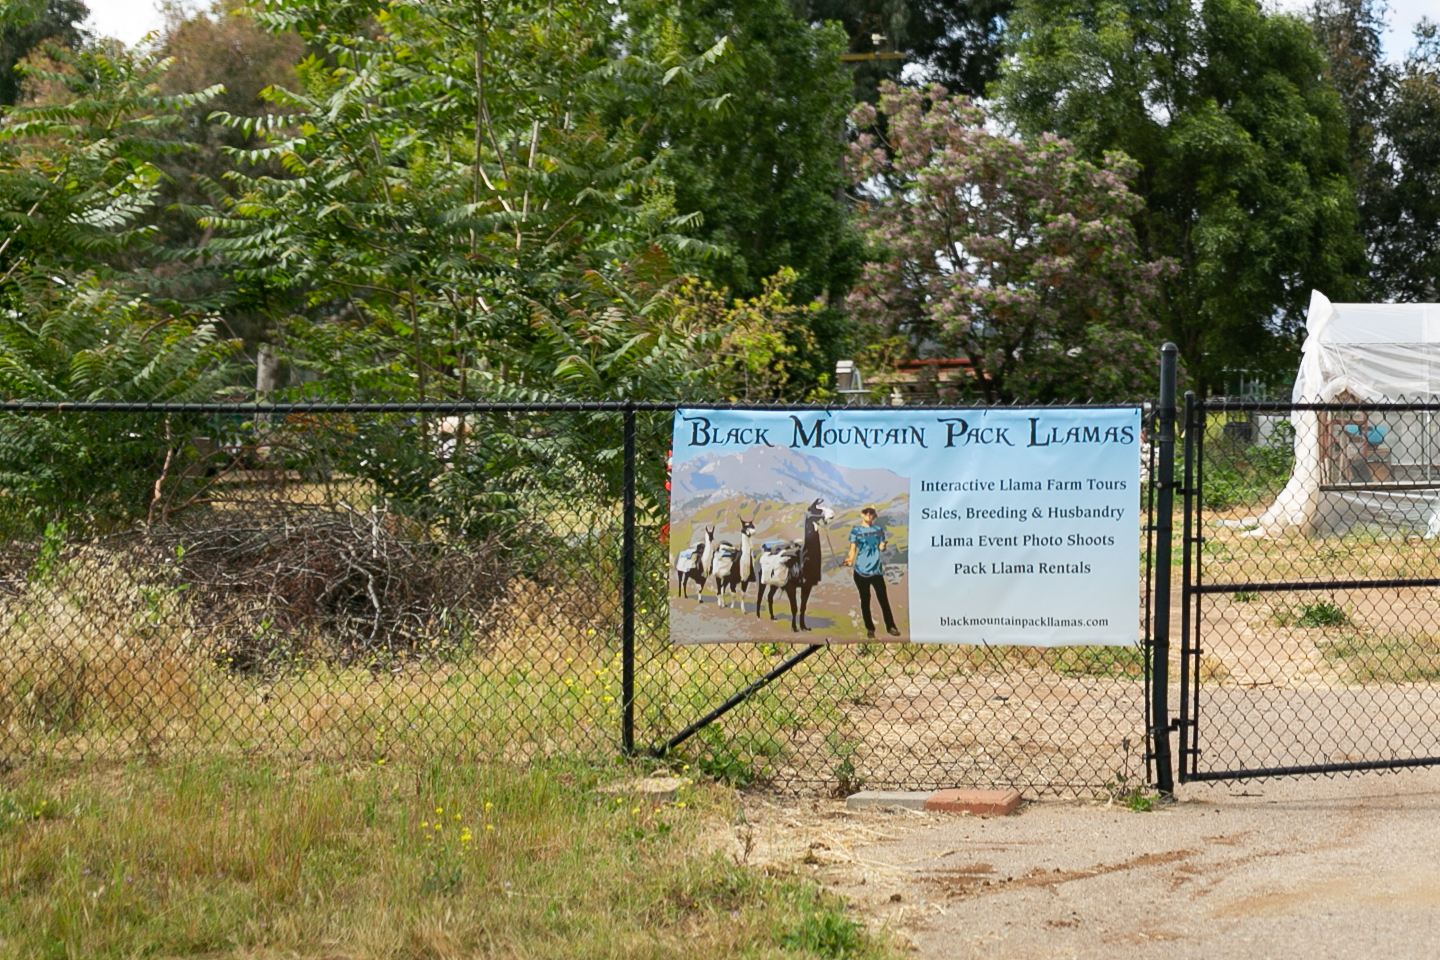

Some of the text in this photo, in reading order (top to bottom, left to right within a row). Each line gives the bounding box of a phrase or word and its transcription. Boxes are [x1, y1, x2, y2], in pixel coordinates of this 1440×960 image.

[921, 478, 1127, 492] Interactive Llama Farm Tours
[921, 505, 1125, 522] Sales, Breeding & Husbandry
[931, 534, 1115, 547] Llama Event Photo Shoots
[954, 561, 1091, 575] Pack Llama Rentals
[940, 616, 1109, 629] blackmountainpackllamas.com
